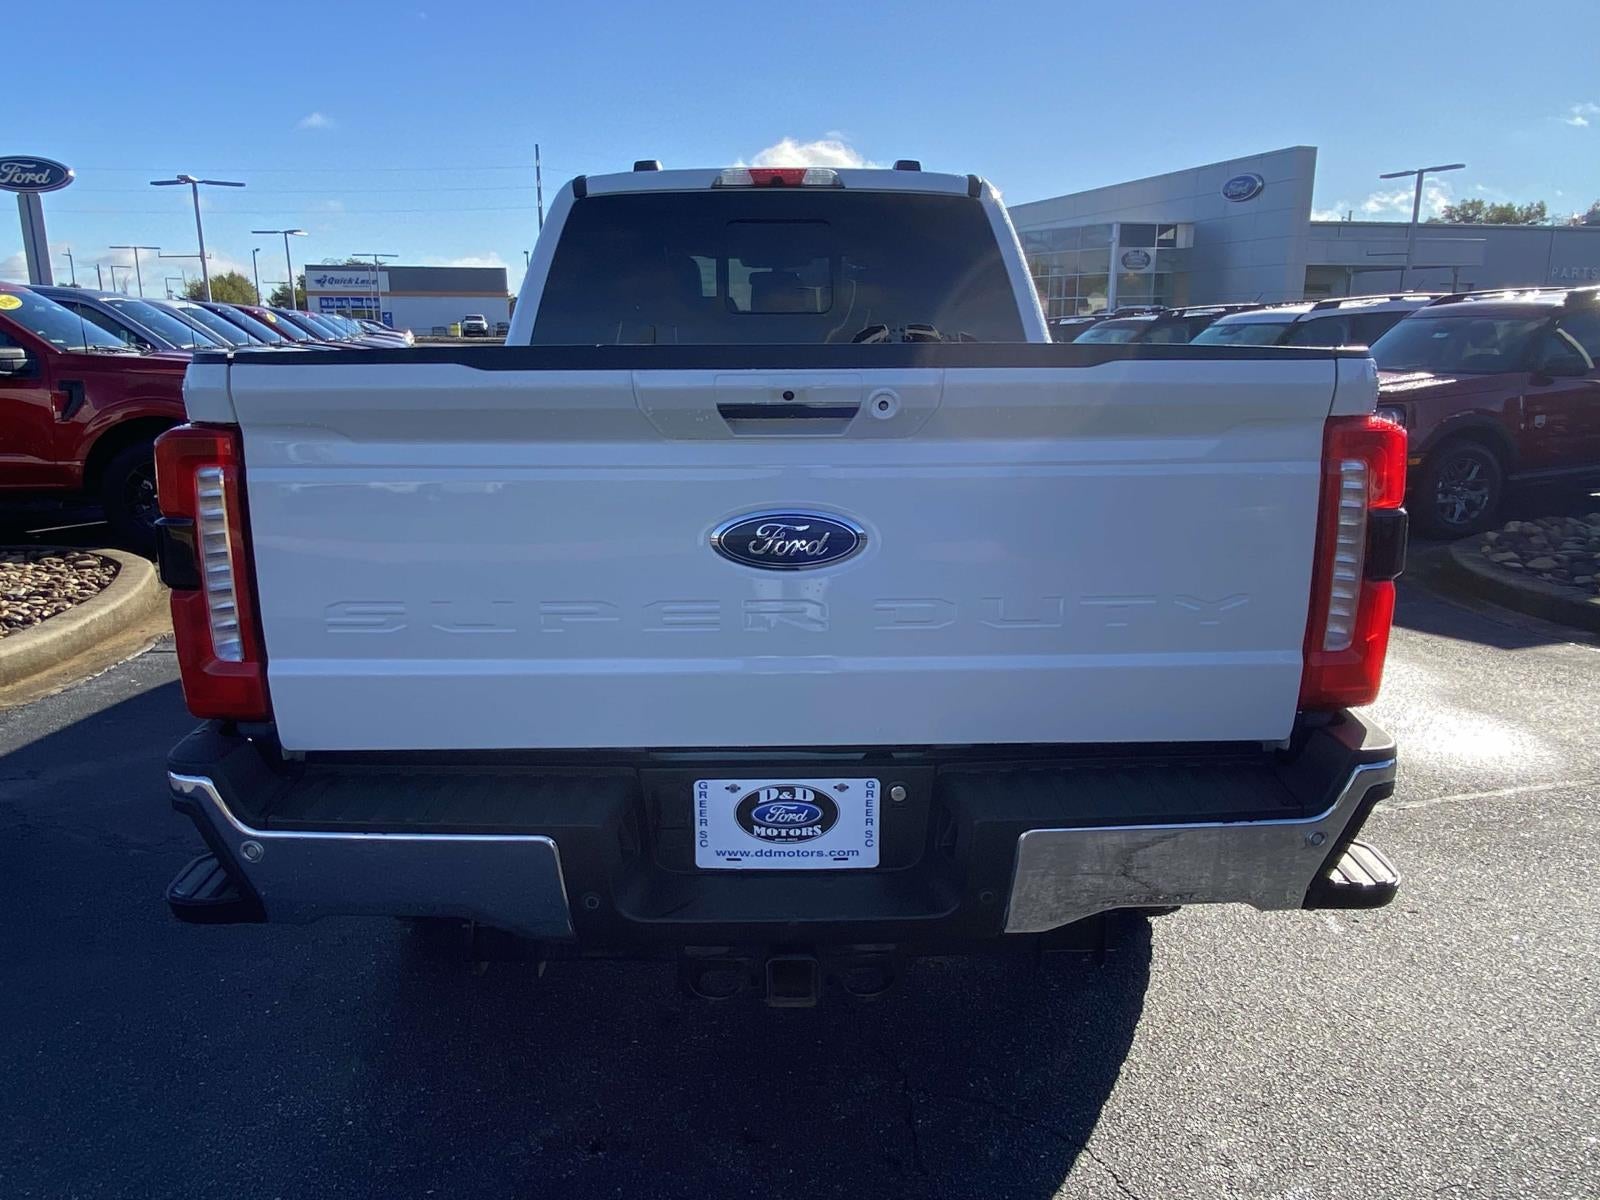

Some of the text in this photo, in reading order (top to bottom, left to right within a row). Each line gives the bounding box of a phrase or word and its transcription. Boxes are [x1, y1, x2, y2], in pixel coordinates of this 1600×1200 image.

[0, 162, 51, 184] Ford
[328, 276, 354, 285] Quick
[1551, 266, 1600, 280] PARTS
[748, 523, 831, 557] Ford
[324, 592, 1250, 633] SUPER DUTY
[758, 787, 815, 803] D&D
[698, 782, 708, 848] GREER SC
[764, 804, 808, 823] Ford
[865, 780, 875, 848] GREER SC
[752, 824, 823, 837] MOTORS
[715, 847, 860, 858] www.ddmotors.com
